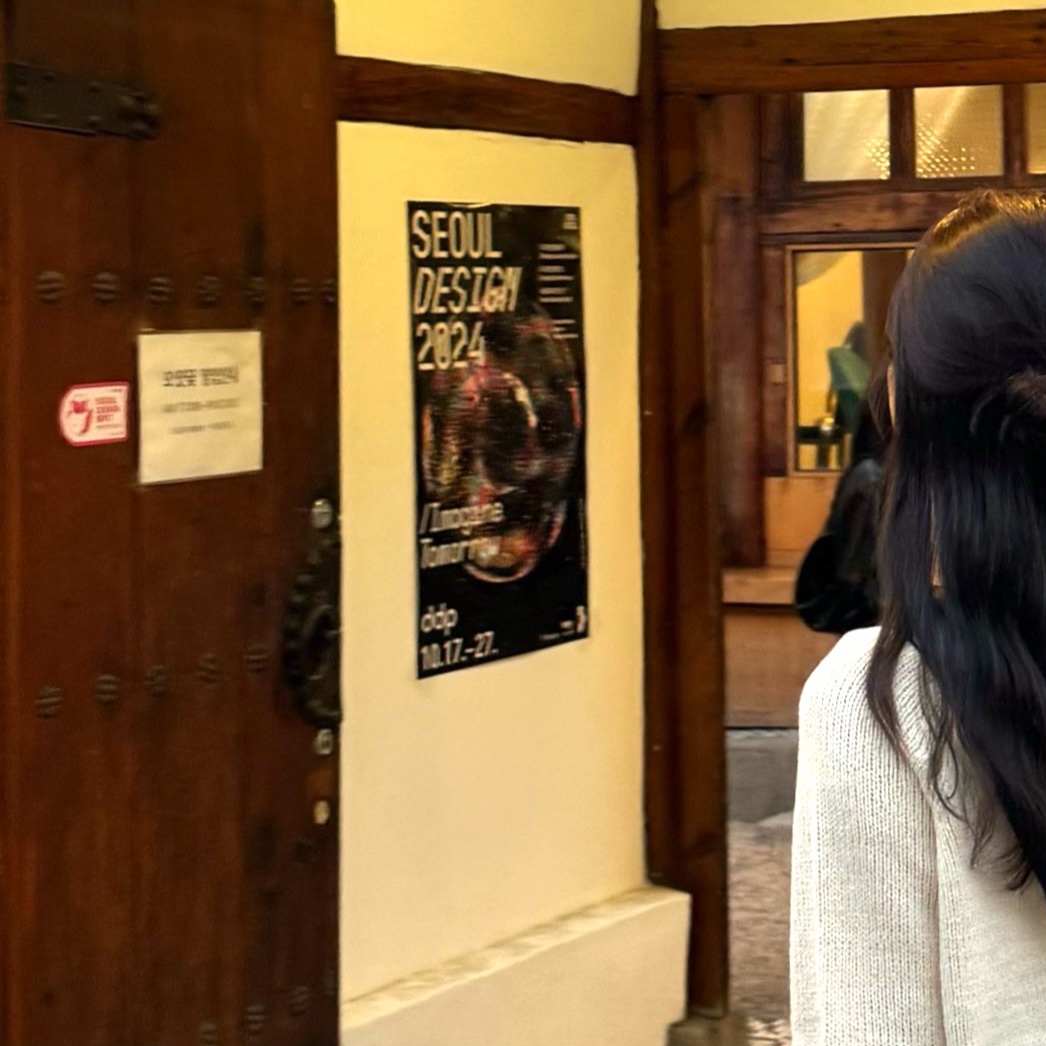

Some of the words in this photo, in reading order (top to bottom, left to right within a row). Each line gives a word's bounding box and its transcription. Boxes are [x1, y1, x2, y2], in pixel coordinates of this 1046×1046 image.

[412, 209, 503, 259] SEOUL
[413, 266, 523, 315] DESIGN
[415, 321, 486, 371] 2024
[420, 603, 459, 636] ddp
